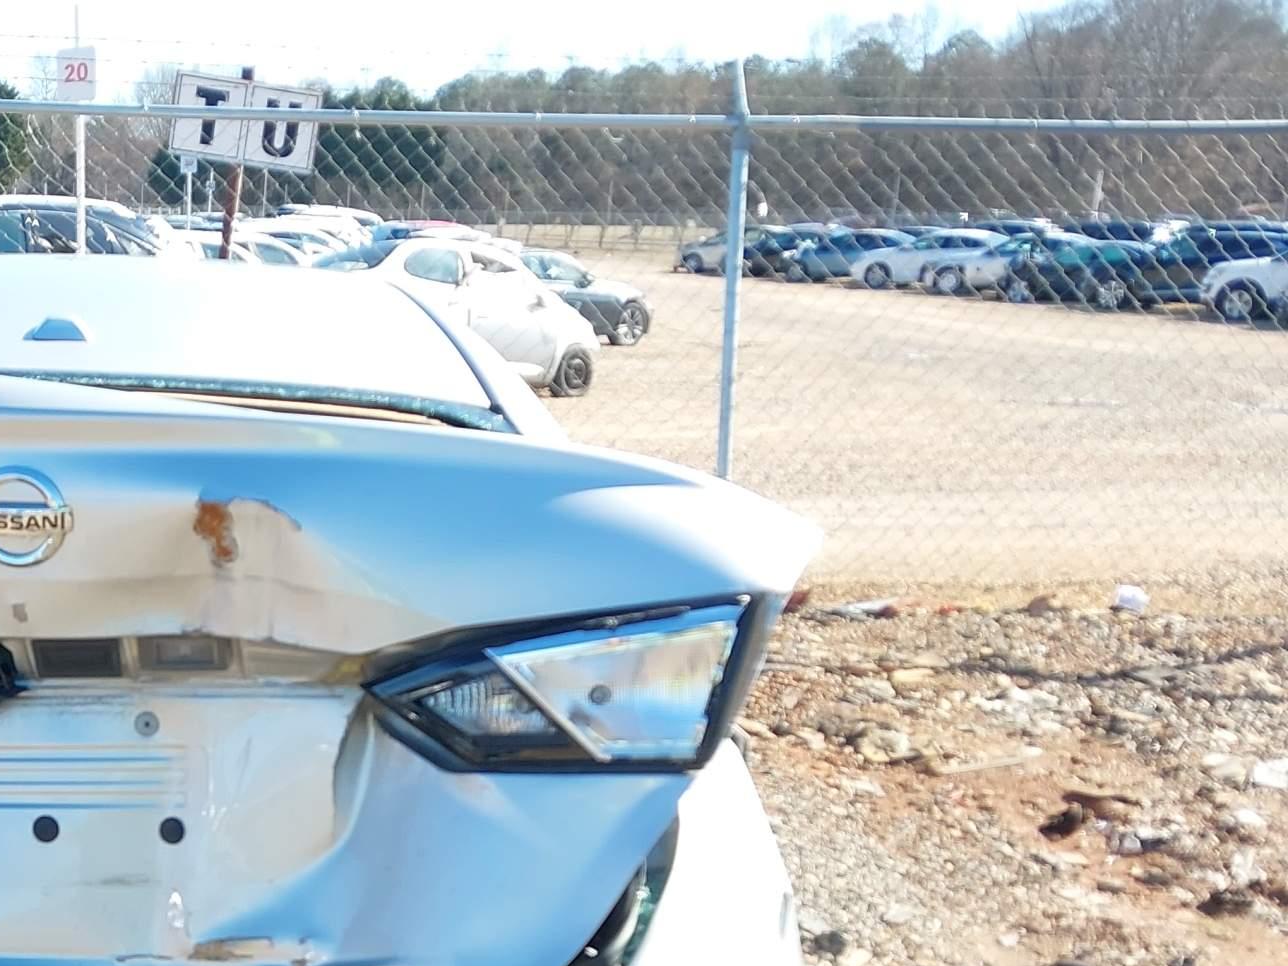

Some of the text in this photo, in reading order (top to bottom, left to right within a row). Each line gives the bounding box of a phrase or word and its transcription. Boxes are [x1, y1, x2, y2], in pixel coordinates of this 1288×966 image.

[64, 62, 88, 83] 20
[196, 85, 302, 158] T U
